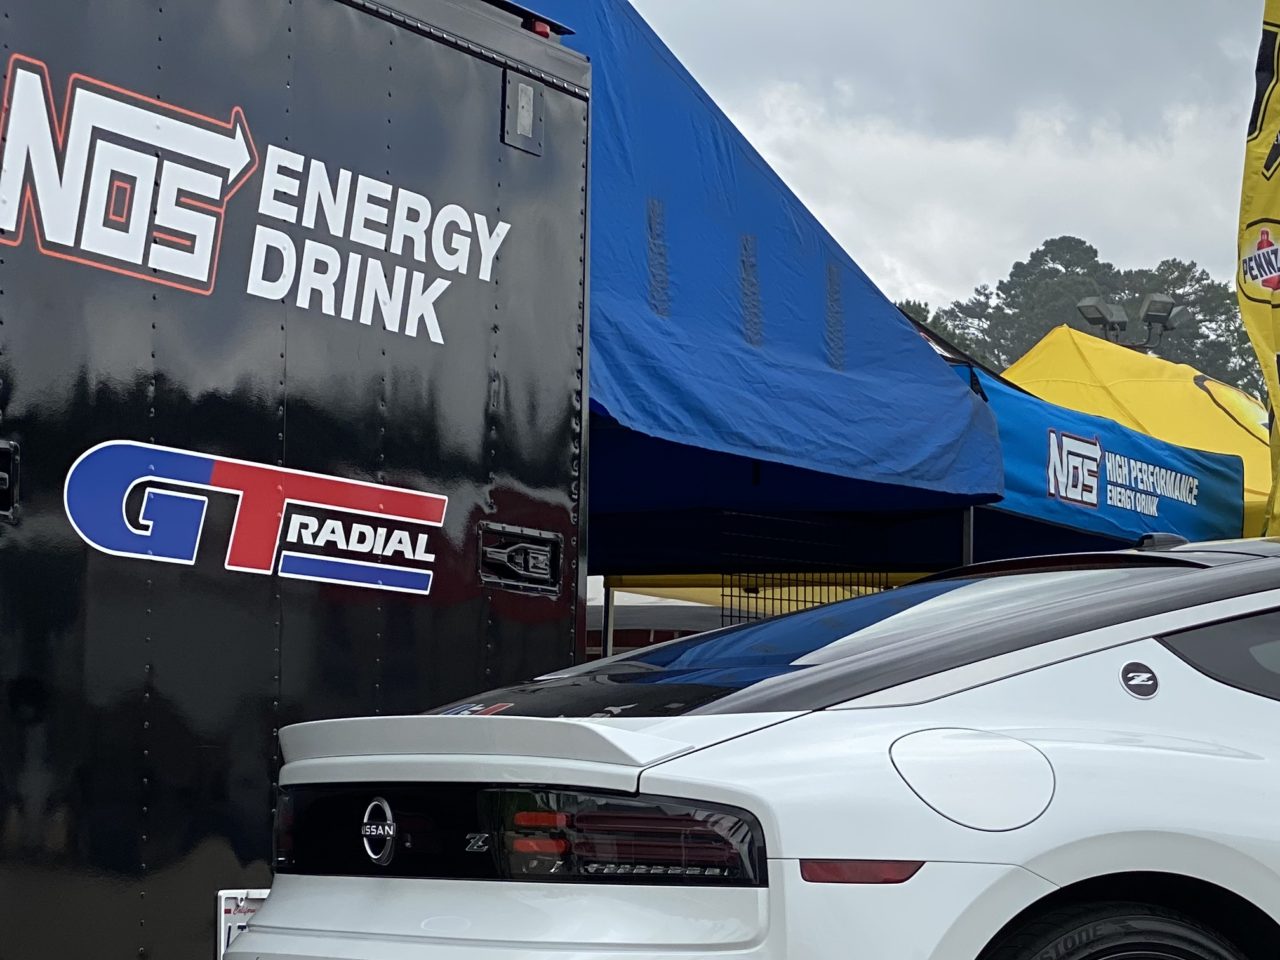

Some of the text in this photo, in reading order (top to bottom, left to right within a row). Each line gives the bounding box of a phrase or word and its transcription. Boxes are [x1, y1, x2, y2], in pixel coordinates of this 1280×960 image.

[0, 67, 252, 284] NOS
[258, 143, 512, 283] ENERGY
[246, 223, 453, 345] DRINK
[64, 439, 448, 576] GT RADIAL
[1048, 431, 1102, 506] NOS
[1105, 451, 1199, 506] HIGH PERFORMANCE
[1106, 484, 1159, 517] ENERGY DRINK
